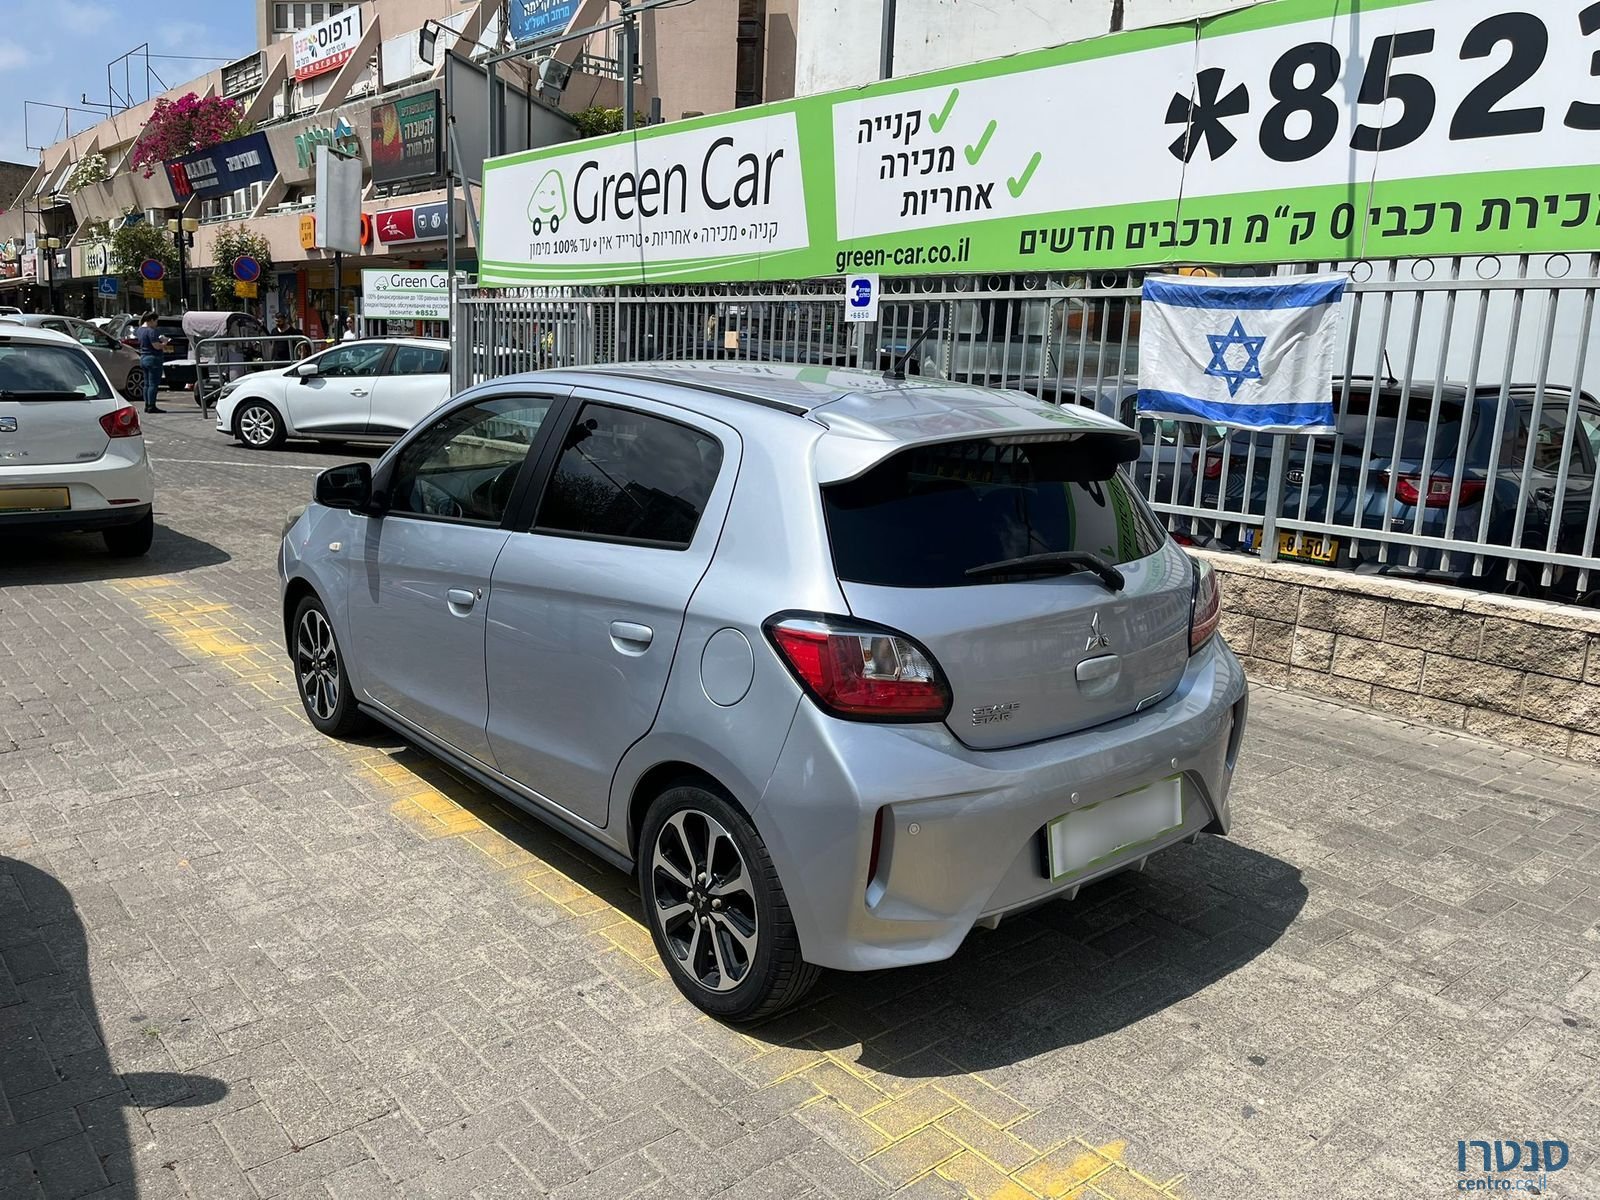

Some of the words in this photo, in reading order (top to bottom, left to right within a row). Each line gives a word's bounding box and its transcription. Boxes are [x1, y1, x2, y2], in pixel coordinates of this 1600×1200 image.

[318, 16, 352, 48] דפוס
[857, 109, 922, 145] קנייה
[879, 145, 955, 180] מכירה
[573, 160, 687, 225] Green
[701, 136, 784, 211] Car
[900, 182, 995, 217] אחריות
[1330, 203, 1356, 240] 0
[1369, 201, 1462, 238] רכבי
[616, 232, 643, 249] טרייד
[652, 228, 691, 247] אחריות
[701, 225, 738, 243] מכירה
[749, 220, 778, 244] קניה
[1019, 224, 1115, 255] חדשים
[1125, 216, 1233, 250] ורכבים
[529, 241, 551, 260] מימון
[553, 240, 578, 254] 100%
[580, 238, 591, 252] עד
[599, 236, 613, 255] אין
[836, 237, 970, 273] green-car.co.il
[391, 274, 427, 288] Green
[972, 702, 1020, 716] SPACE
[972, 713, 1009, 726] STAR
